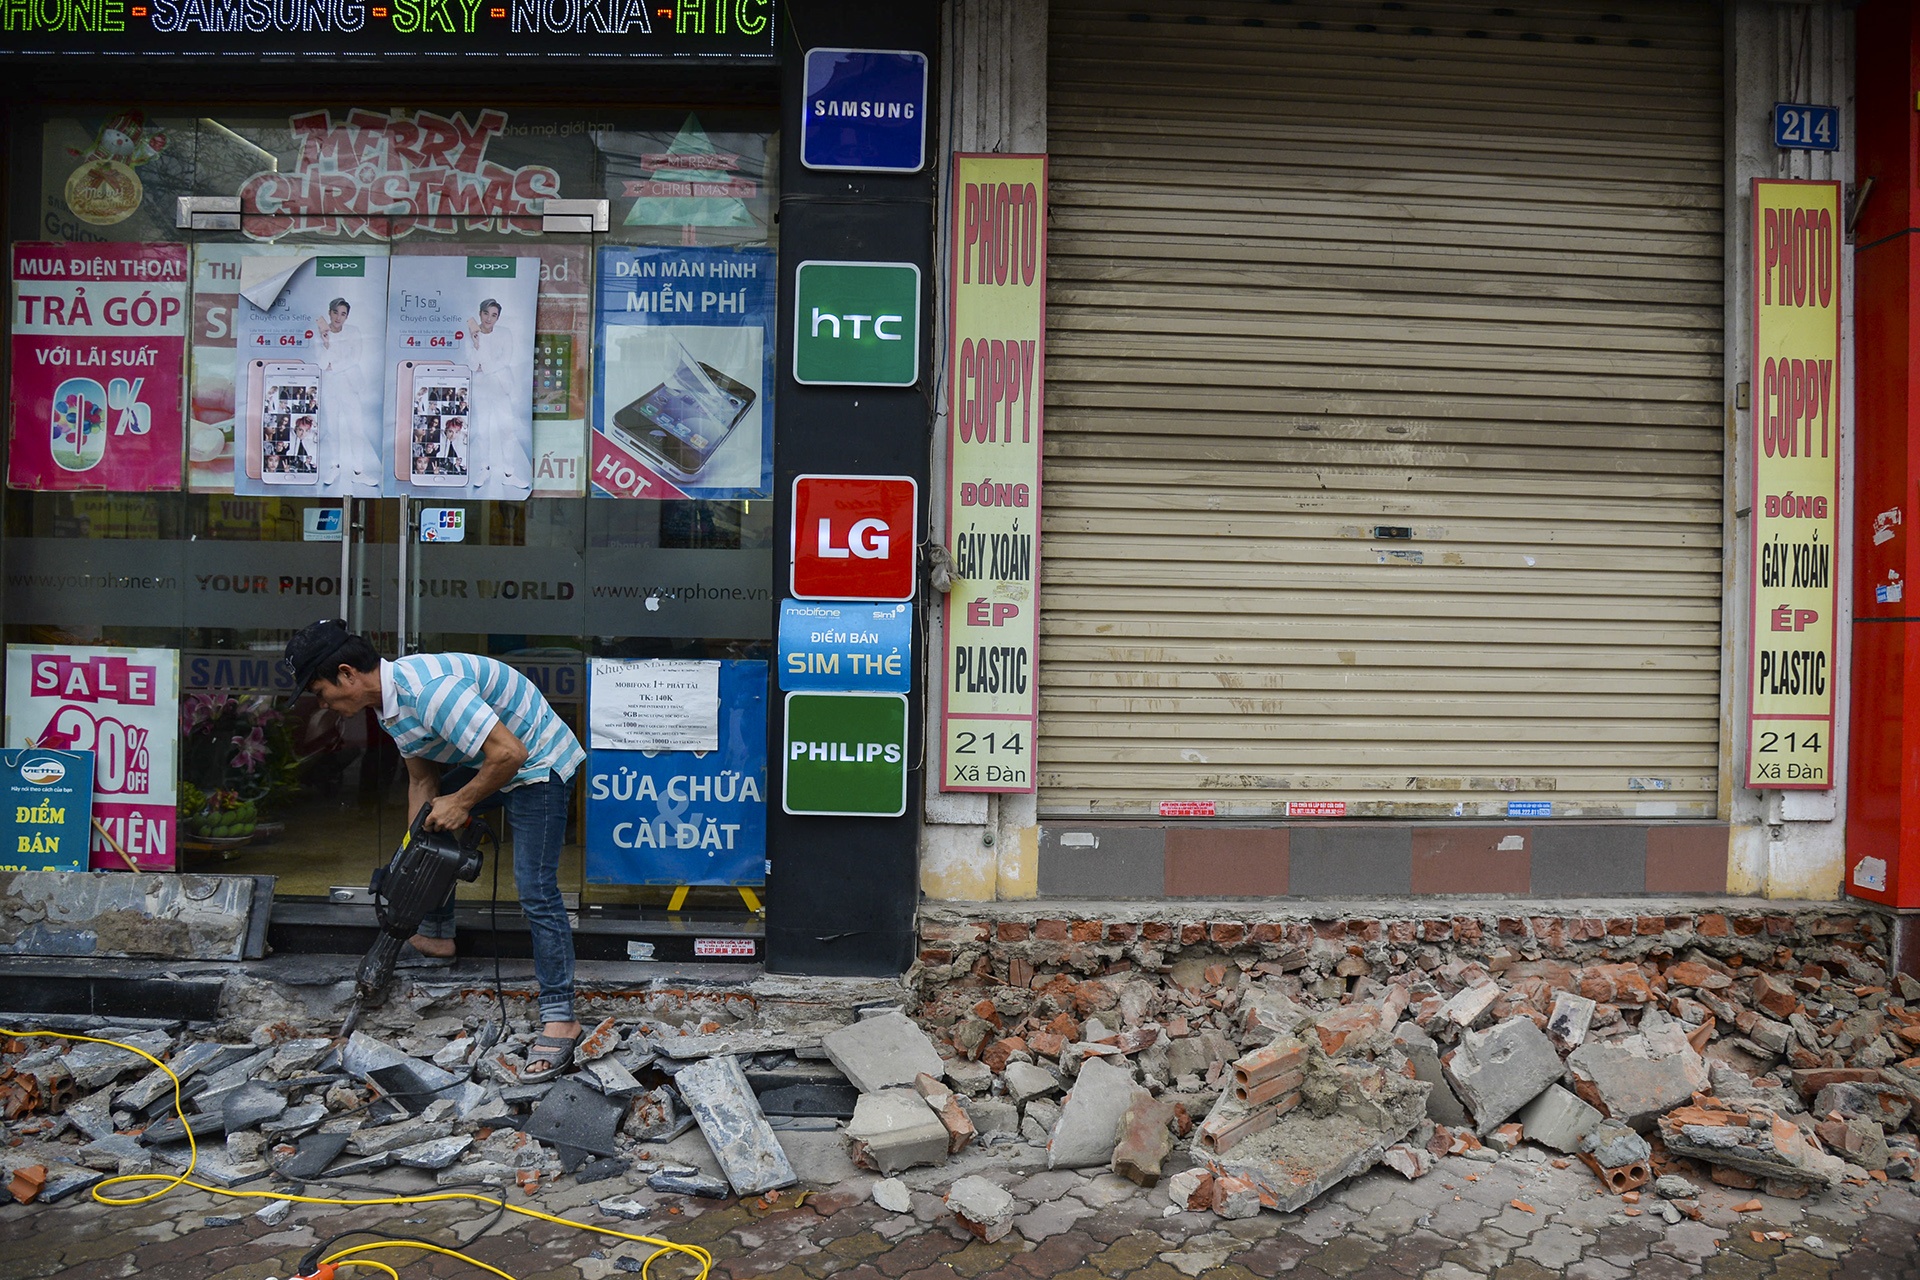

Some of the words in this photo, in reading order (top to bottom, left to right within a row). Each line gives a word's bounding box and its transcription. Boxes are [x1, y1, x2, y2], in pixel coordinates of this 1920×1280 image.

[814, 99, 915, 119] SAMSUNG
[289, 108, 508, 173] MERRY
[1781, 110, 1831, 143] 214
[667, 156, 714, 168] MERRY
[238, 161, 561, 241] CHRISTMAS
[652, 184, 729, 196] CHRISTMAS
[963, 182, 1037, 286] PHOTO
[20, 258, 66, 276] MUA
[70, 256, 117, 281] ĐIỆN
[121, 259, 181, 281] THOẠI
[616, 258, 656, 278] DÁN
[661, 258, 705, 278] MÀN
[710, 259, 757, 279] HÌNH
[1764, 207, 1832, 308] PHOTO
[18, 287, 93, 326] TRẢ
[103, 290, 181, 327] GÓP
[626, 282, 694, 313] MIỄN
[701, 287, 747, 314] PHÍ
[278, 313, 290, 321] Gia
[292, 313, 312, 322] Selfie
[399, 314, 428, 324] Chuyên
[429, 314, 441, 322] Gia
[442, 314, 462, 323] Selfie
[35, 345, 71, 366] VỚI
[76, 347, 106, 367] LÃI
[111, 345, 159, 367] SUẤT
[959, 337, 1036, 444] COPPY
[1763, 356, 1833, 459] COPPY
[51, 377, 151, 473] 0%
[595, 453, 652, 498] HOT
[960, 478, 1030, 508] ĐÓNG
[1765, 491, 1828, 519] ĐÓNG
[439, 515, 461, 523] JCB
[818, 518, 890, 560] LG
[957, 523, 987, 581] GÁY
[990, 518, 1031, 581] XOẮN
[1762, 533, 1789, 588] GÁY
[1792, 528, 1829, 588] XOẮN
[8, 571, 177, 591] www.yourphone.vn
[195, 574, 270, 594] YOUR
[476, 579, 574, 600] WORLD
[591, 583, 768, 604] www.yourphone.vn
[785, 606, 841, 617] mobifone
[967, 597, 1020, 627] ÉP
[1771, 604, 1819, 632] ÉP
[811, 628, 847, 644] ĐIỂM
[850, 629, 879, 645] BÁN
[787, 652, 840, 674] SIM
[847, 647, 902, 675] THẺ
[955, 646, 1027, 695] PLASTIC
[1760, 650, 1826, 696] PLASTIC
[36, 661, 149, 700] SALE
[790, 741, 901, 763] PHILIPS
[955, 731, 1024, 755] 214
[1759, 731, 1822, 753] 214
[127, 771, 147, 791] OFF
[592, 766, 659, 803] SỬA
[667, 770, 761, 803] CHỮA
[953, 764, 980, 782] Xã
[986, 765, 1026, 782] Đàn
[1756, 763, 1781, 779] Xã
[1787, 763, 1823, 780] Đàn
[15, 798, 66, 825] ĐIỂM
[17, 832, 60, 853] BÁN
[612, 817, 666, 850] CÀI
[675, 818, 741, 857] ĐẶT
